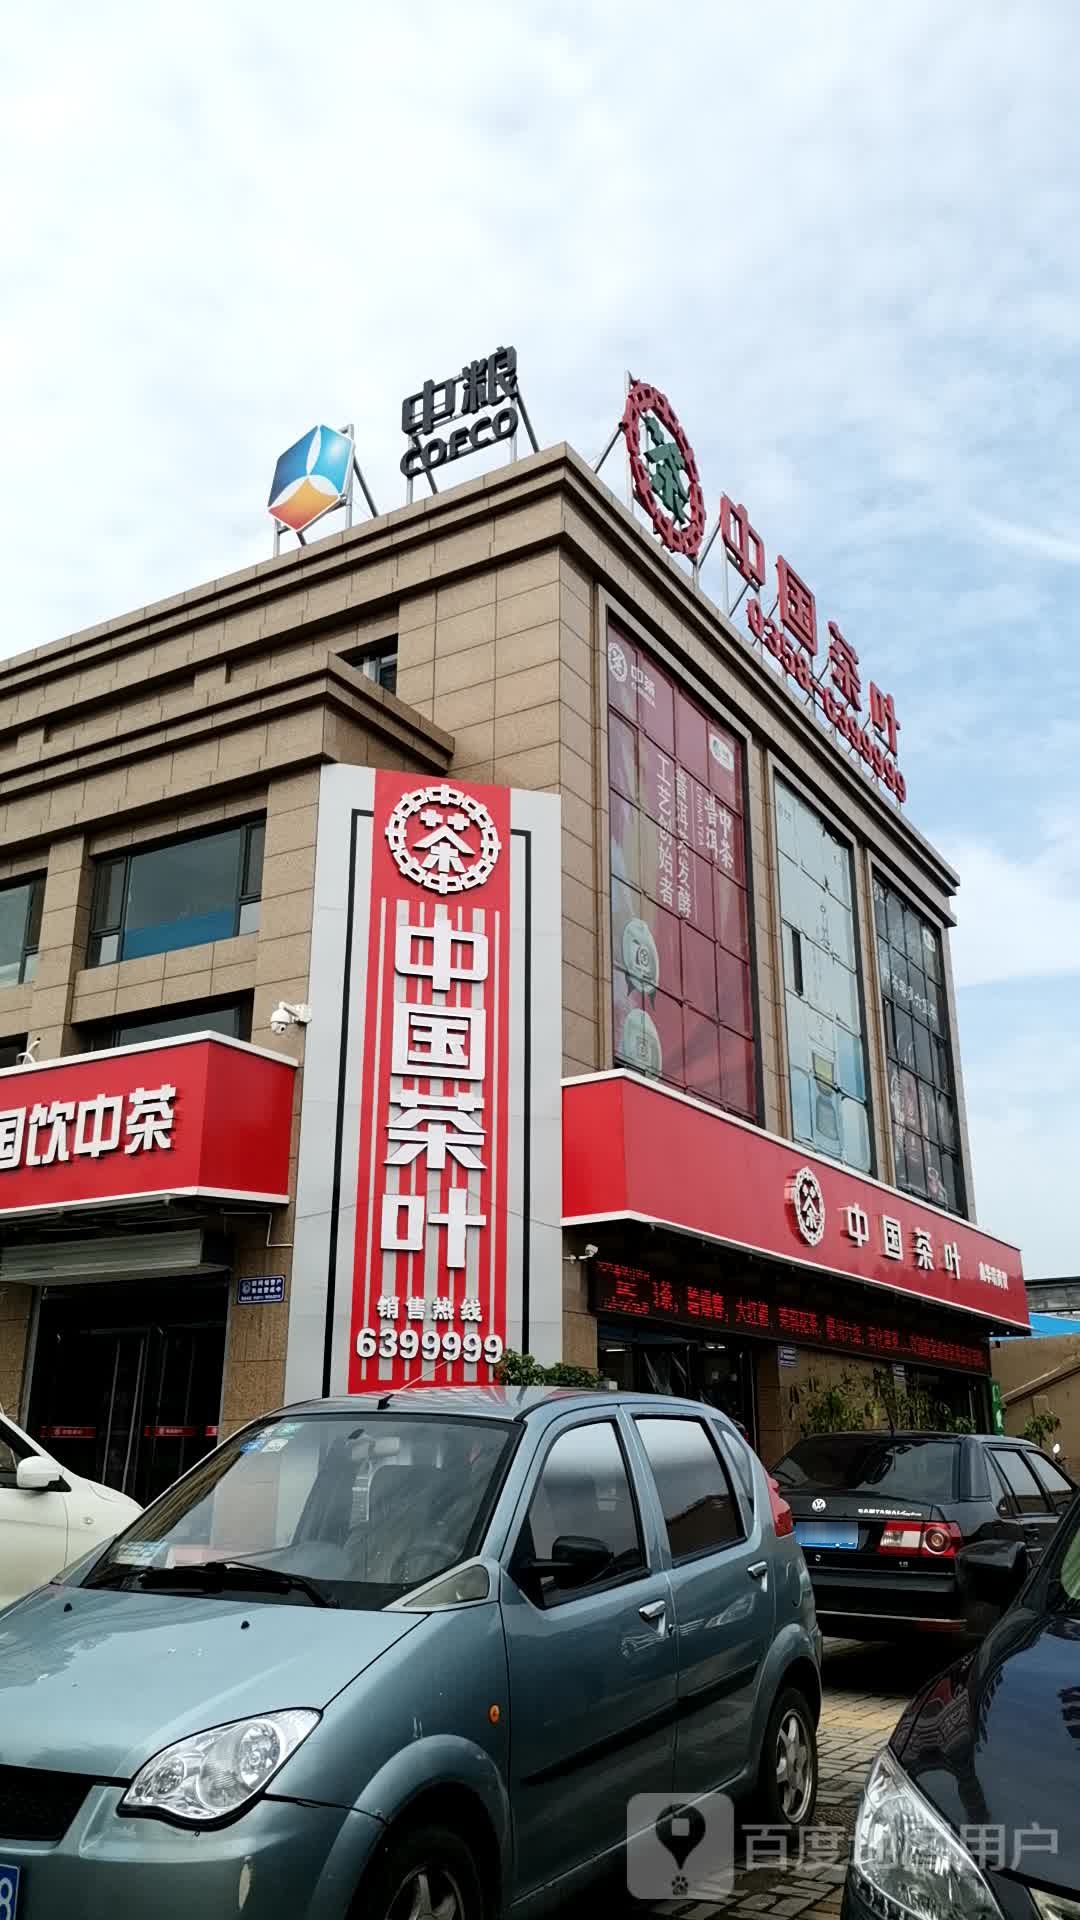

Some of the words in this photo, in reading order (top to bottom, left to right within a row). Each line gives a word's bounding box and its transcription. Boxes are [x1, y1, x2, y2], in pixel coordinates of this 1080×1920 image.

[402, 345, 518, 436] 中粮
[400, 407, 518, 478] COFCO
[719, 495, 901, 758] 中国茶叶
[0, 1083, 177, 1170] 国饮中茶
[380, 918, 489, 1269] 中国茶叶
[847, 1202, 961, 1280] 中国茶叶
[356, 1327, 504, 1364] 6399999
[377, 1295, 483, 1322] 销售热线
